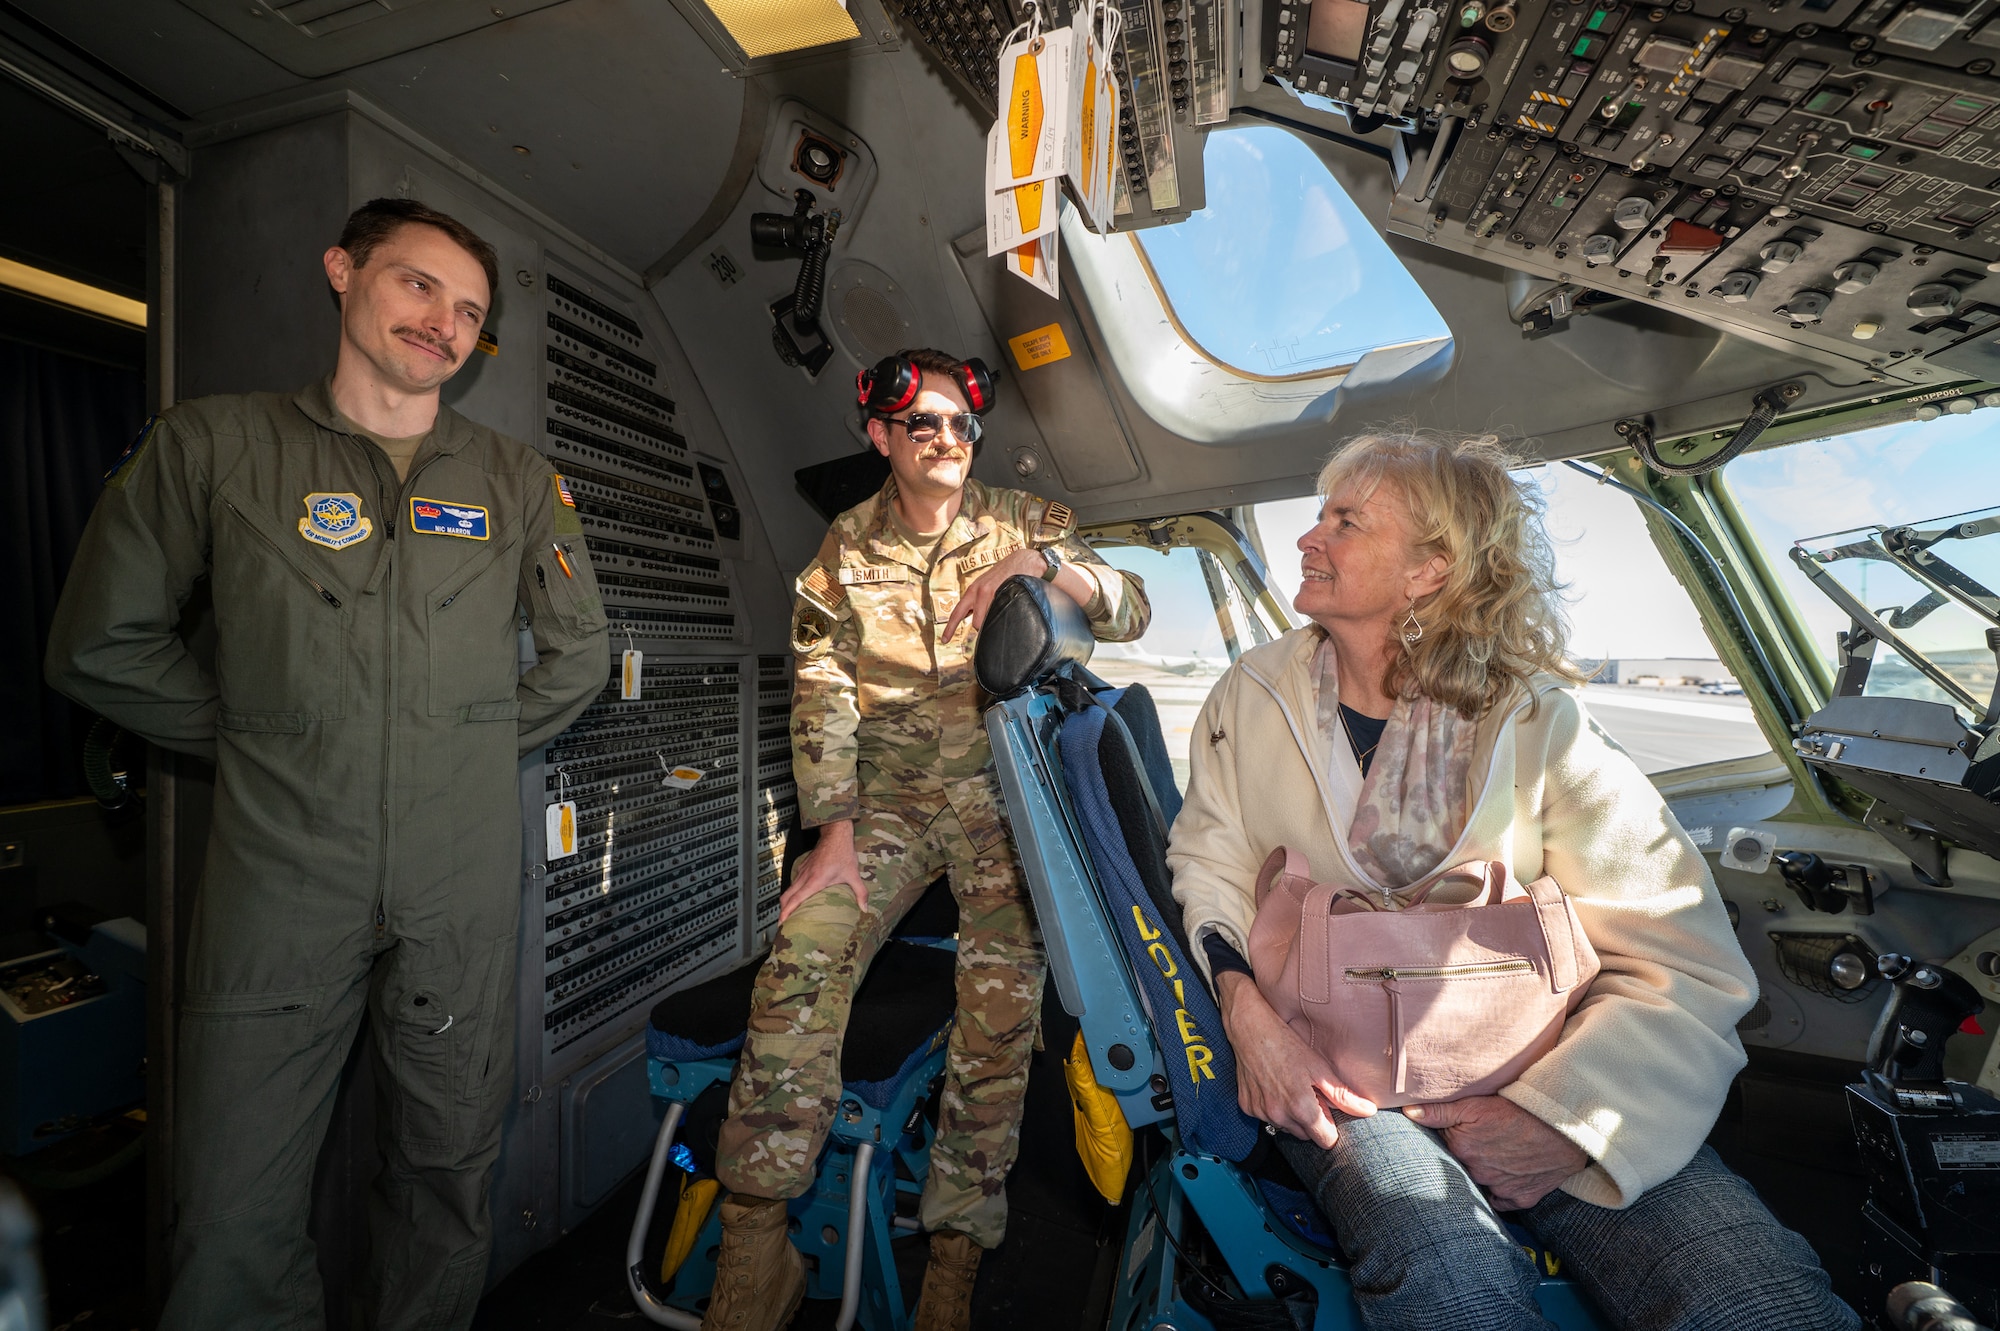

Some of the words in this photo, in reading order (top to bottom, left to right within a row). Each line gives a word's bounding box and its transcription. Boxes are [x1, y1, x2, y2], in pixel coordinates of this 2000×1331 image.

[1557, 41, 1566, 51] LEFT
[1549, 79, 1557, 88] FUEL
[1555, 67, 1564, 77] TANK
[1020, 89, 1030, 140] WARNING
[711, 256, 736, 282] 230
[1026, 342, 1051, 354] EMERGENCY
[304, 529, 314, 538] AIR
[314, 534, 342, 546] MOBILITY
[342, 528, 367, 544] COMMAND
[446, 526, 471, 536] MARRON
[856, 568, 890, 580] SMITH
